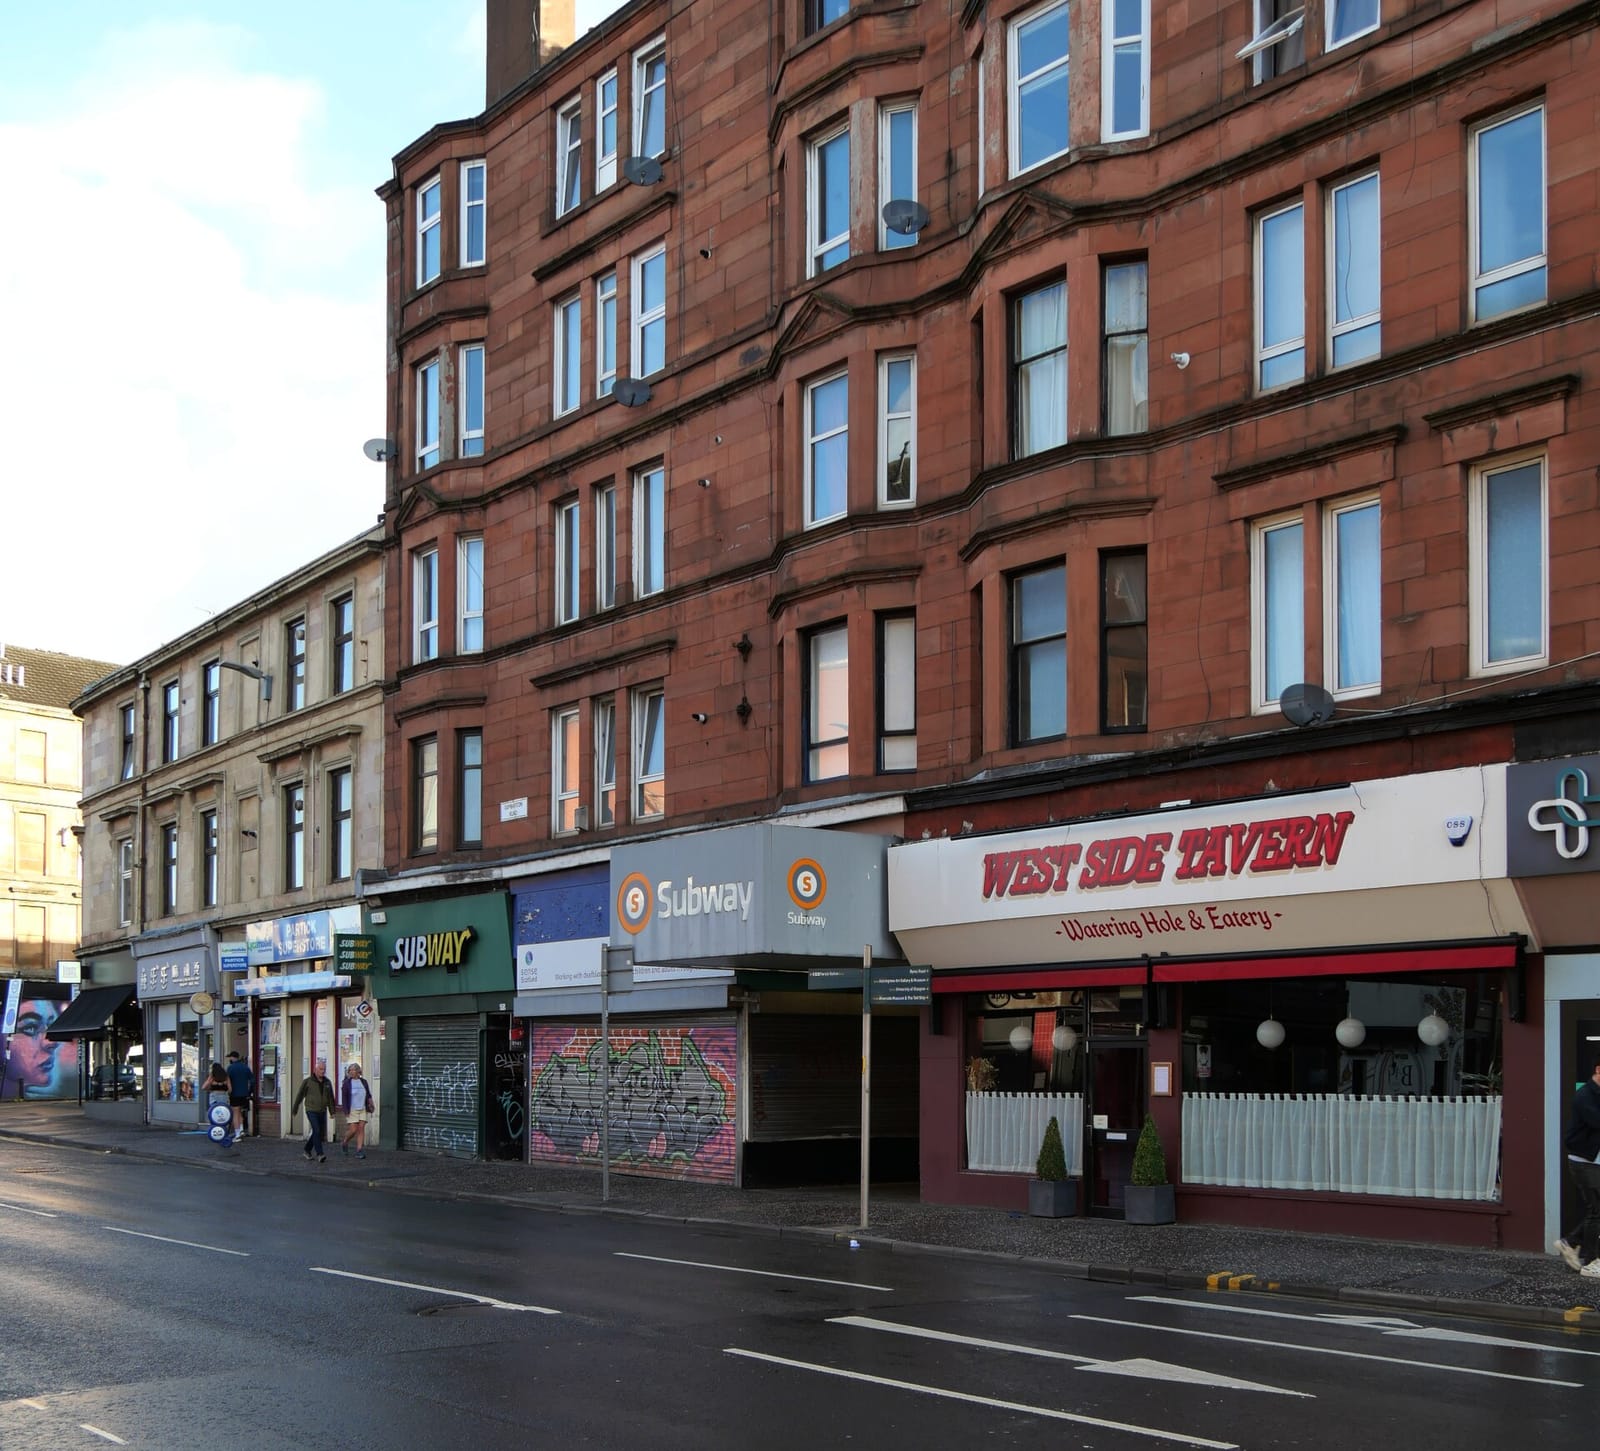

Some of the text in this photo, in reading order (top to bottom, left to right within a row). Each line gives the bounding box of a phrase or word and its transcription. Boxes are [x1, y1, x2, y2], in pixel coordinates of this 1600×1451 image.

[1446, 820, 1466, 829] CSS
[982, 811, 1355, 900] WEST SIDE TAVERN
[657, 876, 754, 921] Subway
[787, 911, 827, 929] Subway
[1144, 909, 1186, 935] Hole
[1189, 909, 1206, 931] &
[278, 936, 326, 956] SUPERSTORE
[339, 939, 373, 948] SUBWAY
[390, 929, 472, 970] SUBWAY
[339, 951, 373, 959] SUBWAY
[339, 962, 373, 970] SUBWAY
